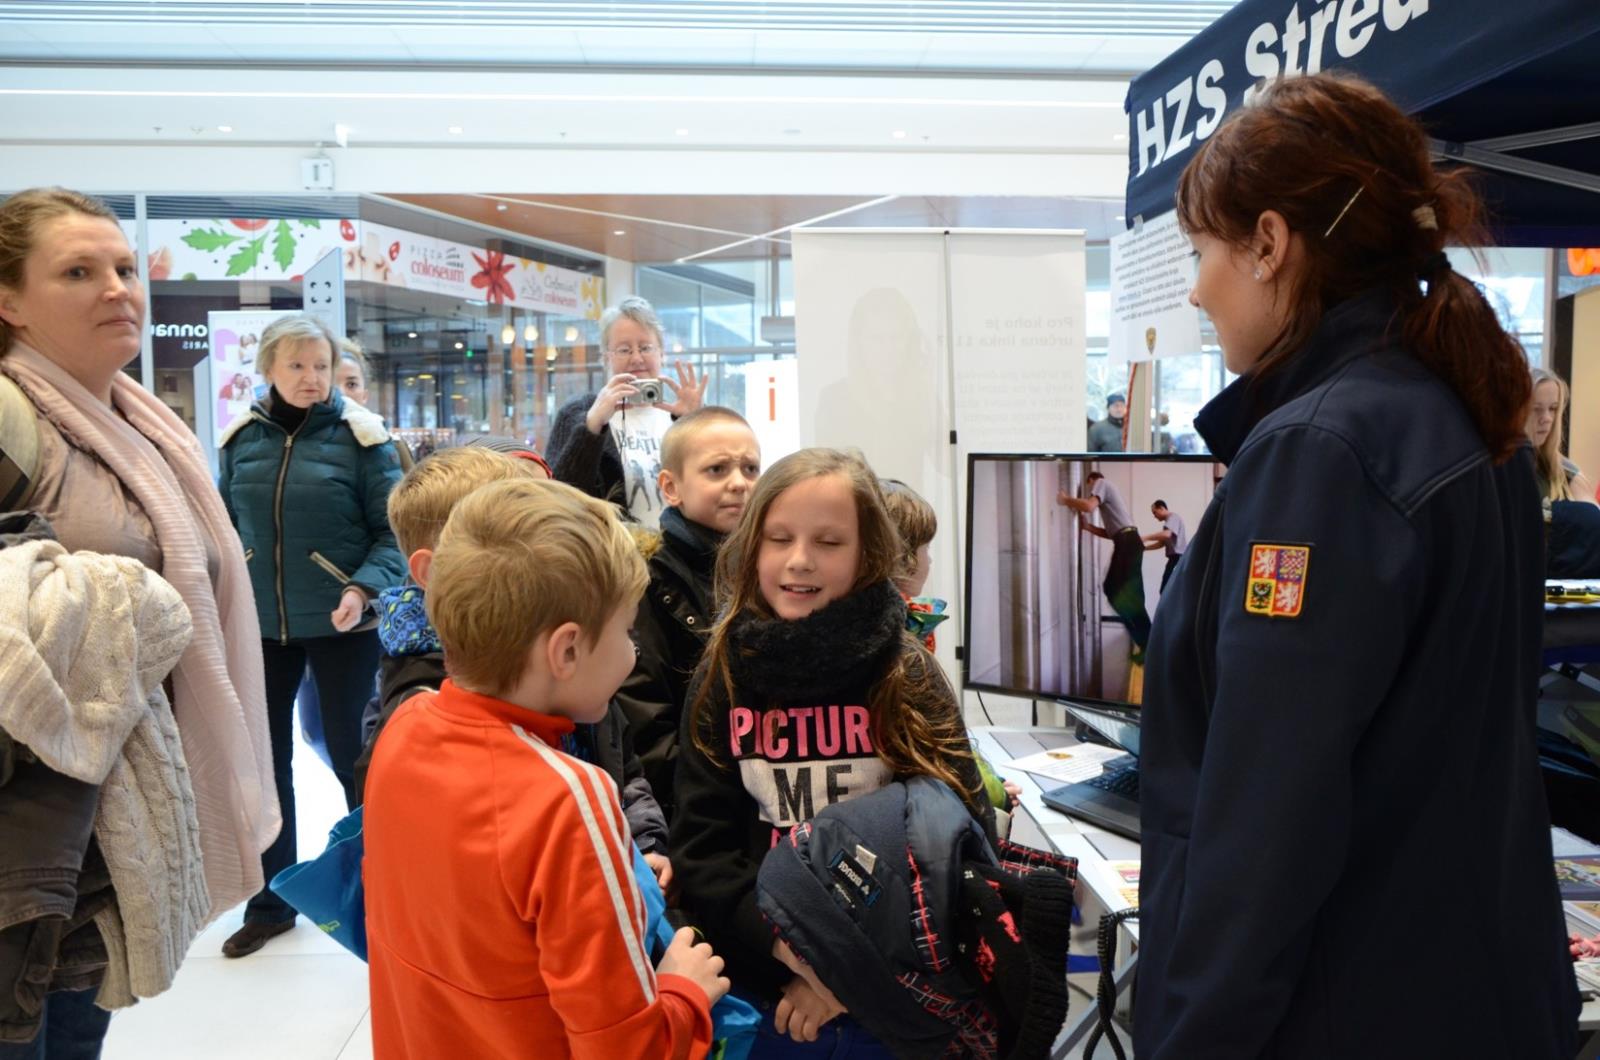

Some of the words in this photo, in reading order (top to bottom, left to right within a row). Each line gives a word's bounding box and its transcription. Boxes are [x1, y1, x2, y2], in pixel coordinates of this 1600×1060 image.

[1136, 59, 1226, 177] HZS
[410, 245, 443, 260] PIZZA
[410, 256, 465, 283] coloseum
[729, 705, 880, 759] PICTUR
[772, 764, 853, 823] ME
